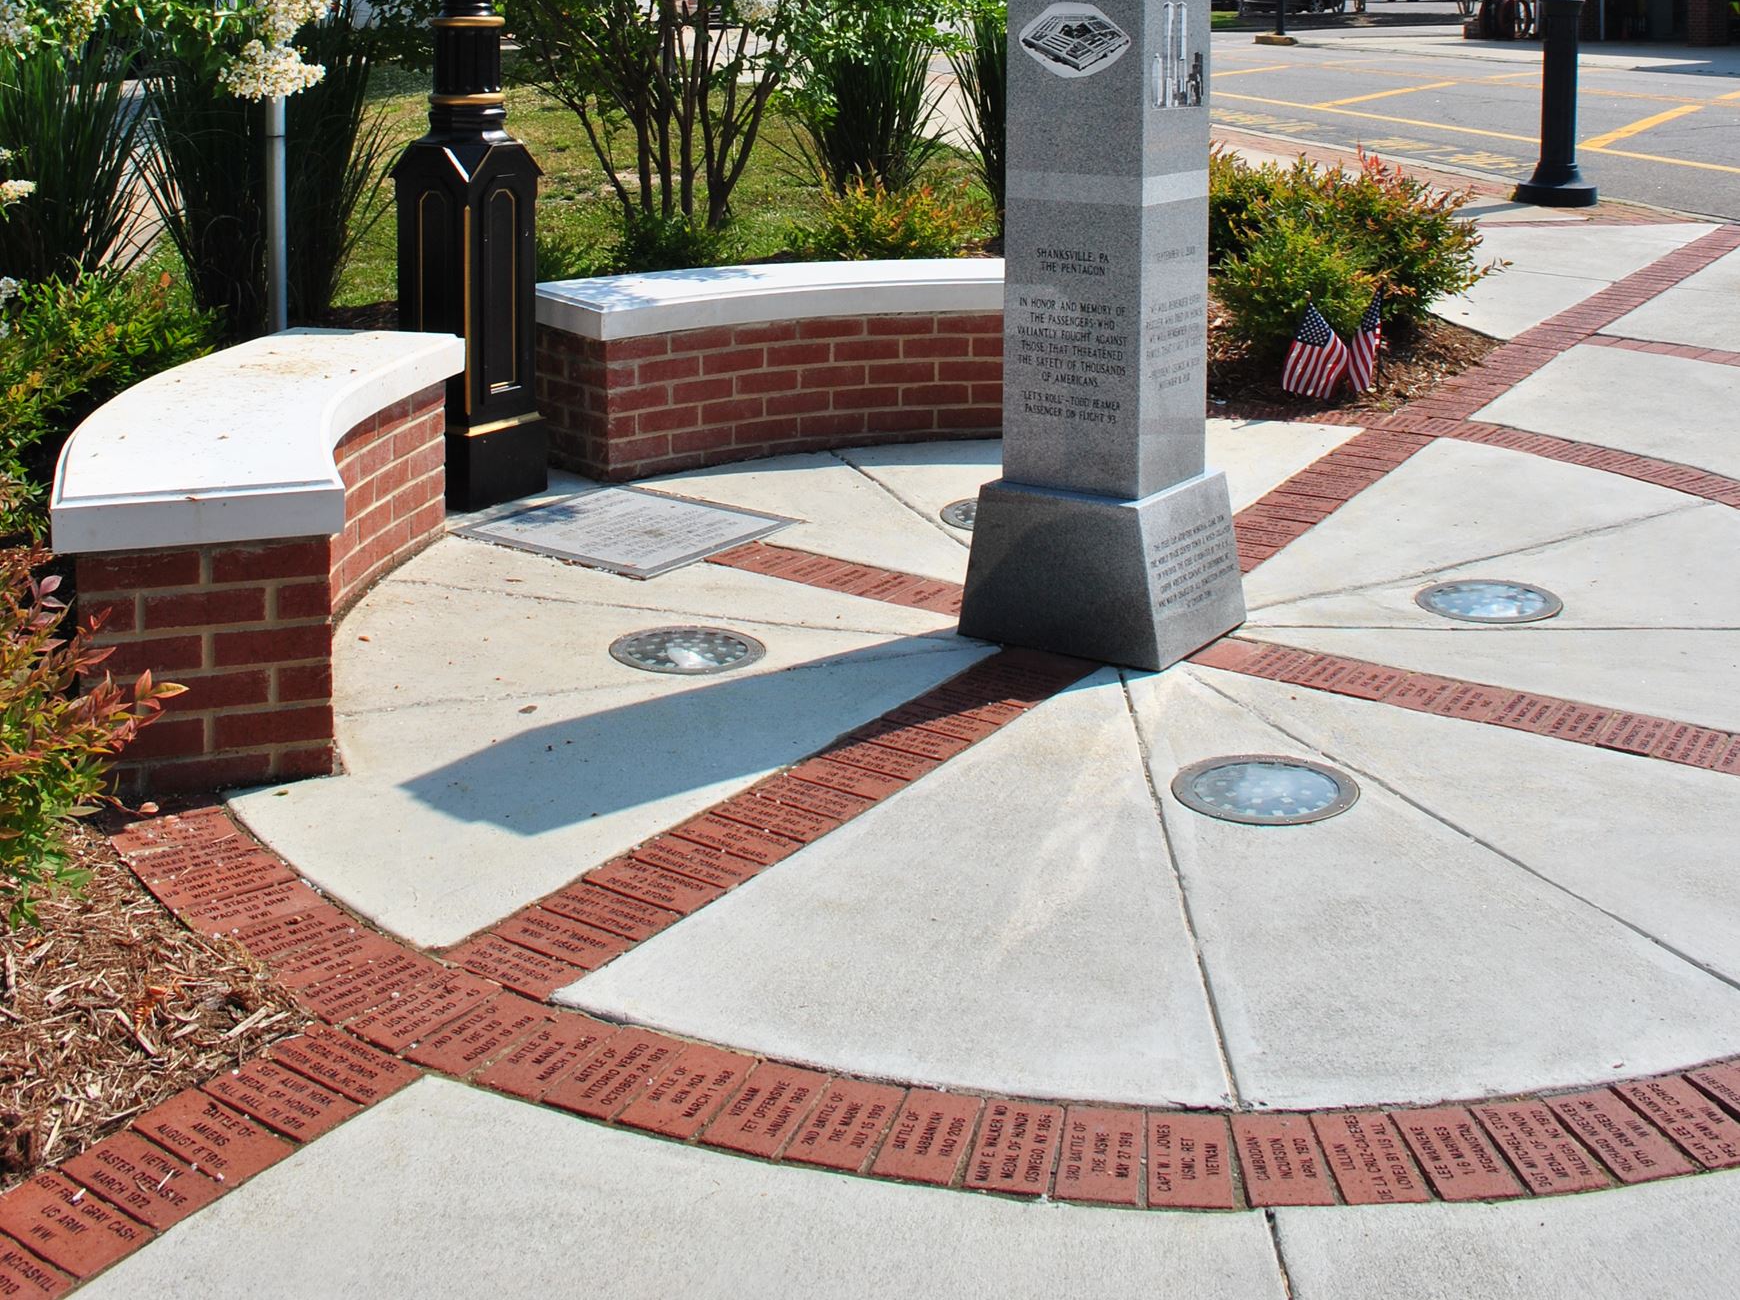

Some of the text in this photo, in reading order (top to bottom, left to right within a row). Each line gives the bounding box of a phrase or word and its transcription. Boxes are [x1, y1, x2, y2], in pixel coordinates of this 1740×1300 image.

[1040, 261, 1106, 276] THE PENTAGON
[1099, 253, 1110, 264] PA
[1019, 297, 1126, 317] IN HONOR AND MEMORY OF
[1030, 311, 1045, 324] THE
[1017, 326, 1128, 347] VALIANTLY FOUGHT AGAINST
[1021, 339, 1123, 361] THOSE THAT THREATENED
[1017, 354, 1126, 376] THE SAFETY OF THOUSANDS
[1041, 371, 1051, 382] OF
[164, 890, 180, 899] US
[184, 881, 212, 893] ARMY
[172, 872, 212, 888] JOSEPH
[227, 861, 255, 873] HACK
[192, 885, 229, 900] WORLD
[232, 878, 257, 888] WAR
[305, 955, 406, 999] APEX ROTARY CLUB
[320, 961, 417, 1006] THANKS VETERANS
[325, 965, 434, 1017] SERVICE ABOVE SELF
[432, 1004, 501, 1050] 2ND BATTLE OF
[462, 1020, 502, 1045] THE LYS
[462, 1015, 535, 1062] AUGUST 19 1918
[507, 1030, 553, 1065] BATTLE OF
[532, 1041, 566, 1065] MANILA
[536, 1035, 598, 1082] MARCH 3 1945
[574, 1047, 618, 1083] BATTLE OF
[580, 1043, 650, 1099] VITTORIO VENETO
[600, 1048, 669, 1106] OCTOBER 24 1918
[215, 1082, 240, 1097] PALL
[239, 1093, 264, 1110] MALL
[265, 1107, 284, 1119] TN
[236, 1074, 321, 1119] MEDAL OF HONOR
[279, 1077, 309, 1093] ALVIN
[307, 1090, 336, 1107] YORK
[728, 1086, 761, 1117] VIETNAM
[739, 1080, 791, 1134] TET OFFENSIVE
[202, 1105, 256, 1139] BATTLE OF
[762, 1087, 810, 1138] JANUARY 1968
[1623, 1120, 1650, 1138] WWII
[155, 1124, 196, 1149] AUGUST
[190, 1122, 230, 1147] AMIENS
[892, 1110, 920, 1150] BATTLE OF
[915, 1111, 944, 1156] HABBANIYAH
[1156, 1124, 1171, 1150] JONES
[1181, 1137, 1195, 1152] RET
[1433, 1126, 1466, 1160] MARINES
[1559, 1102, 1638, 1173] RICHARD NOECKER
[1578, 1100, 1657, 1168] 19TH ARMORED INF
[938, 1138, 957, 1157] IRAQ
[1205, 1142, 1220, 1176] VIETNAM
[1245, 1136, 1271, 1181] CAMBODIAN
[1268, 1137, 1294, 1180] INCURSION
[1292, 1137, 1318, 1180] APRIL 1970
[1332, 1143, 1356, 1171] LILLIAN
[1343, 1114, 1394, 1200] DE LA CRUZ-CACERES
[1370, 1122, 1414, 1190] LOVED BY US ALL
[1409, 1126, 1454, 1180] LEE WARNEKE
[1455, 1123, 1500, 1174] AFGHANISTAN
[1157, 1172, 1172, 1192] CAPT
[35, 1175, 60, 1194] SGT
[81, 1204, 112, 1224] GRAY
[107, 1220, 140, 1241] CASH
[41, 1204, 89, 1236] US ARMY
[30, 1223, 57, 1242] WWI
[3, 1251, 57, 1293] MCCASKILL
